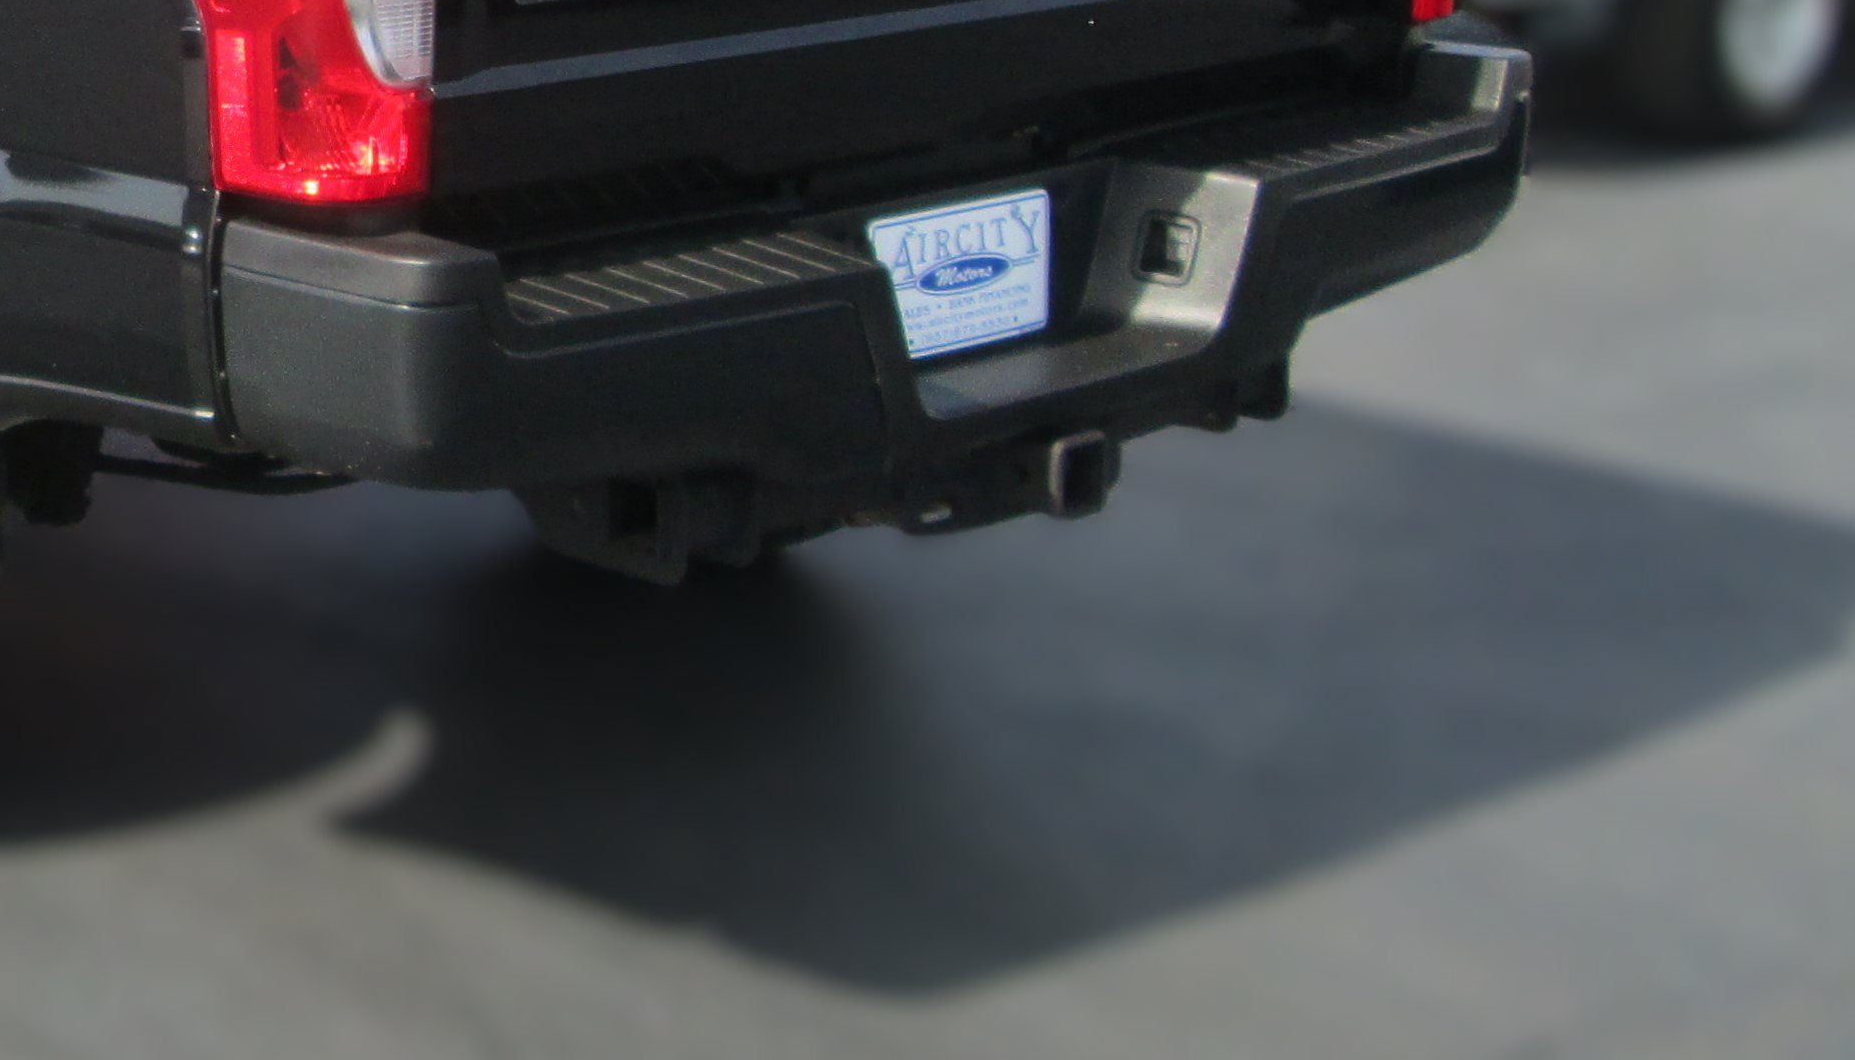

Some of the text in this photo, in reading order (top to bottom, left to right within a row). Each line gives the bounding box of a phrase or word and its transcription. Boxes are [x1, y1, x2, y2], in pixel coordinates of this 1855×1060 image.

[894, 204, 1041, 280] AIRCITY
[935, 265, 994, 287] Motors
[903, 303, 932, 320] ALES
